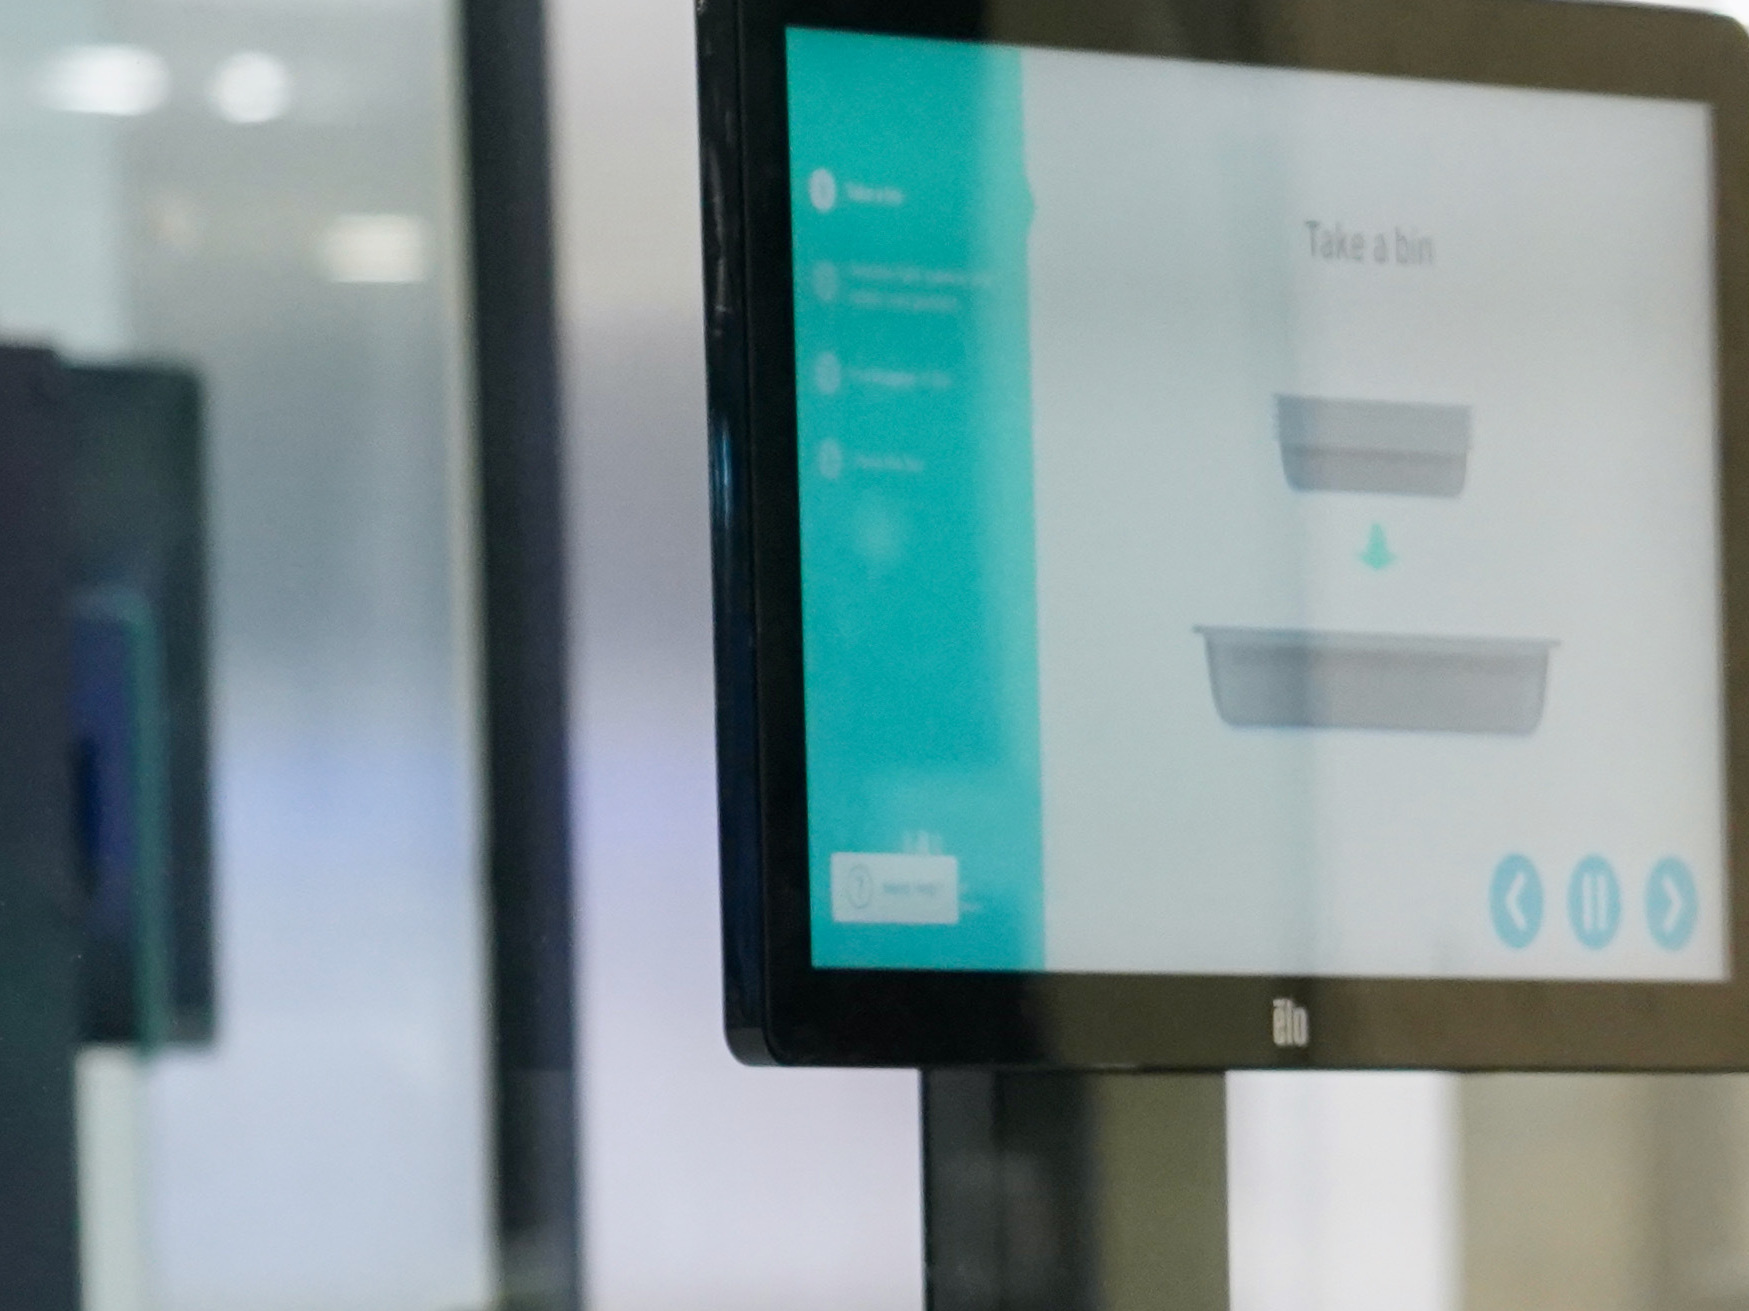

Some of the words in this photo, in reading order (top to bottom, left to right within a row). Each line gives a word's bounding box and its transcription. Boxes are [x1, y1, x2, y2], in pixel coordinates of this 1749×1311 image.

[1303, 220, 1364, 260] Take
[1372, 232, 1388, 264] a
[1394, 226, 1434, 266] bin
